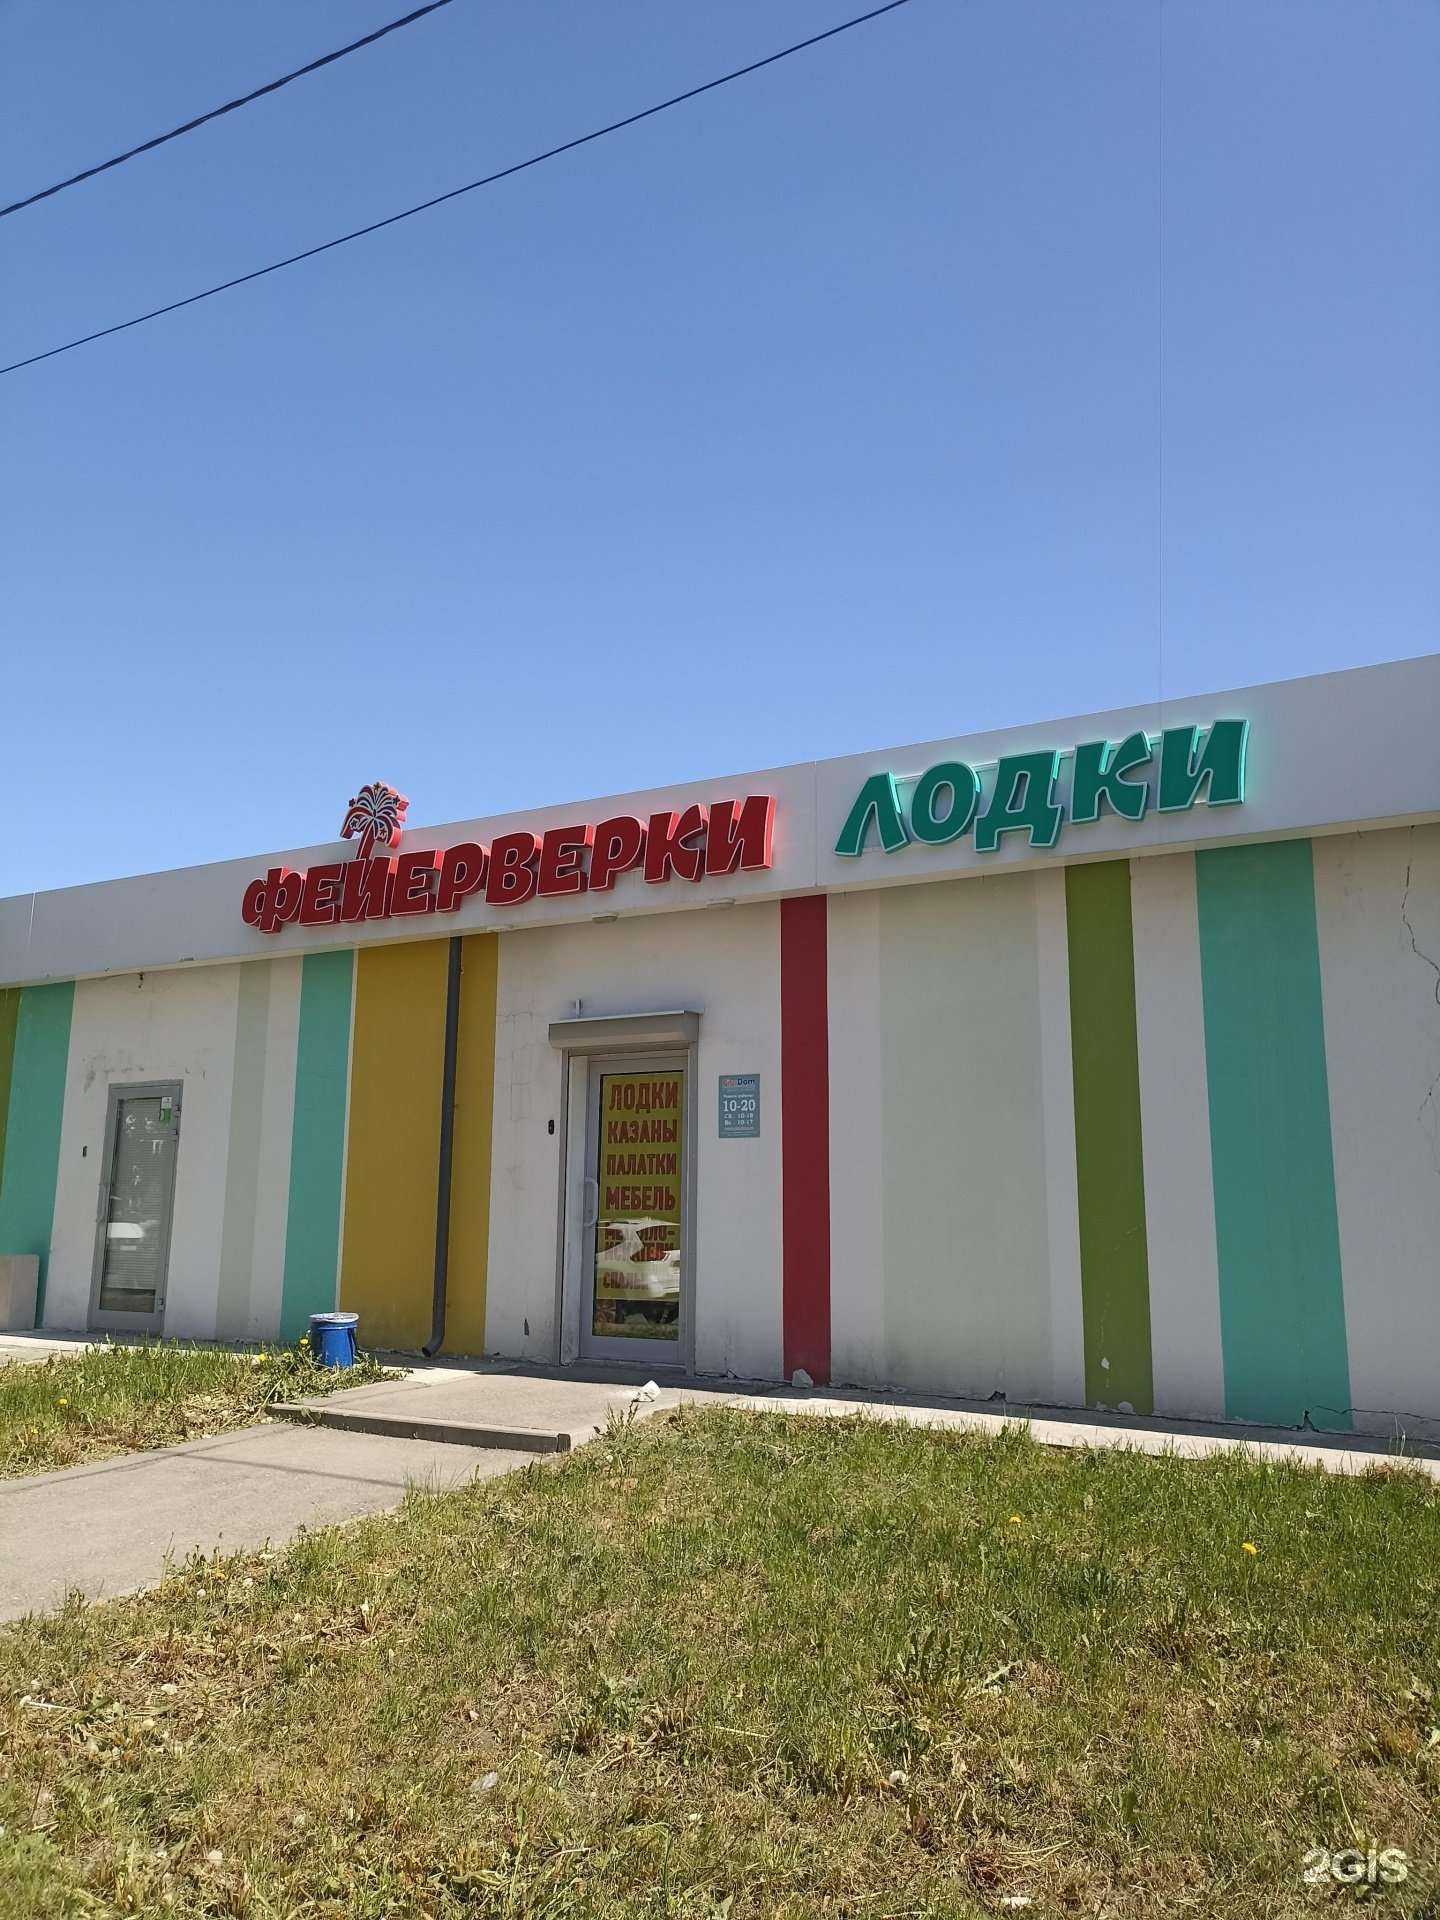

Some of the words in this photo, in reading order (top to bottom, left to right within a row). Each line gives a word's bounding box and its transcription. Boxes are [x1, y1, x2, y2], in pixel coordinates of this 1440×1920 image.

[833, 719, 1249, 856] ЛОДКИ
[609, 1082, 678, 1113] ЛОДКИ
[723, 1099, 756, 1111] 10-20
[608, 1120, 677, 1144] КАЗАНЫ
[607, 1153, 676, 1175] ПАЛАТКИ
[606, 1186, 676, 1211] МЕБЕЛЬ
